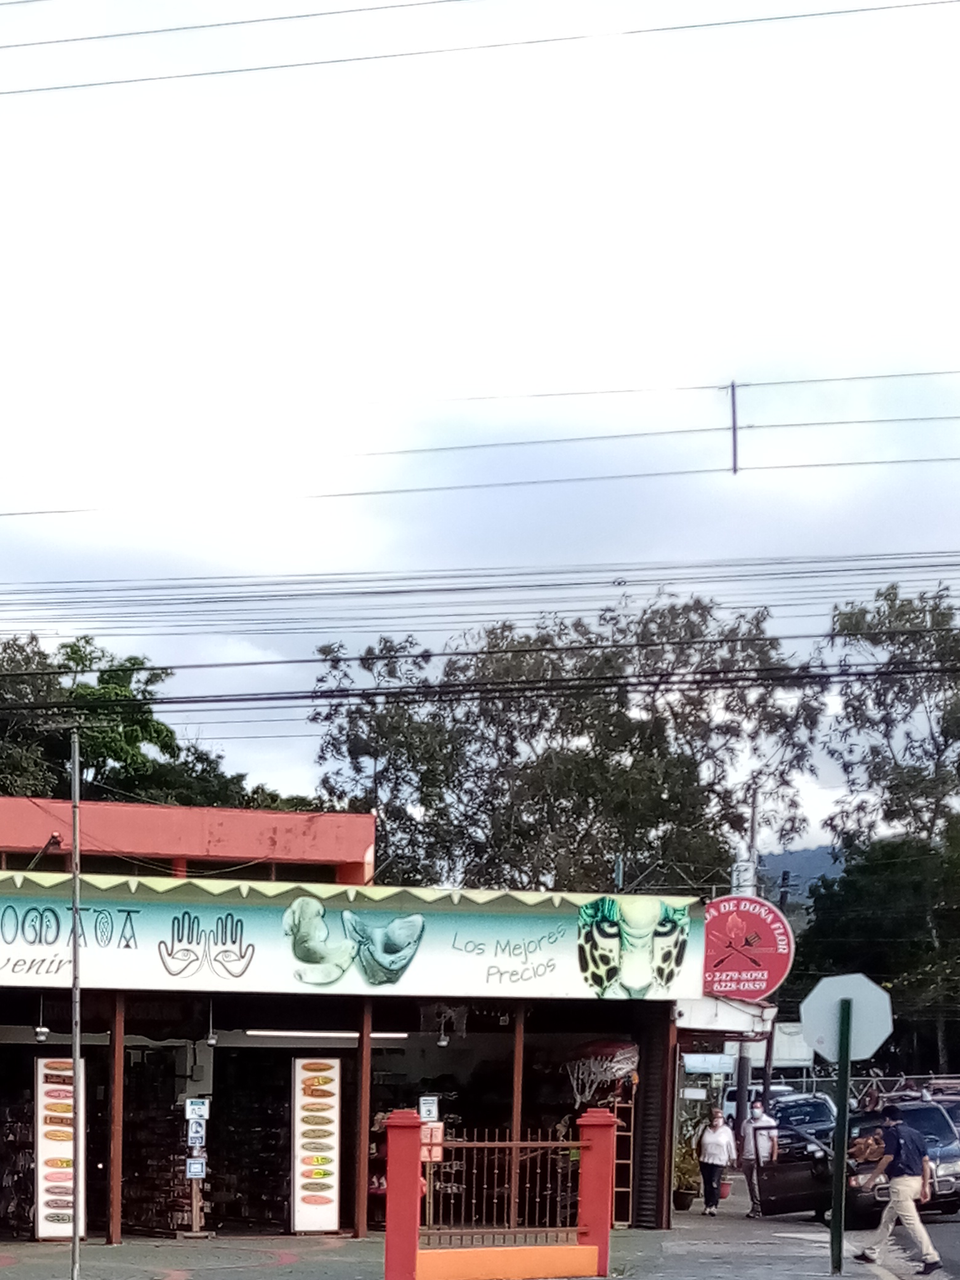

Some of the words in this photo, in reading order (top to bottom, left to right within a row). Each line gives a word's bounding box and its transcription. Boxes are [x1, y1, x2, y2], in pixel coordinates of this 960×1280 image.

[451, 931, 486, 955] Los
[494, 922, 567, 965] Mejores
[720, 900, 737, 914] DE
[739, 900, 774, 924] DOÑA
[770, 922, 789, 954] FLOR
[486, 958, 556, 984] Precios
